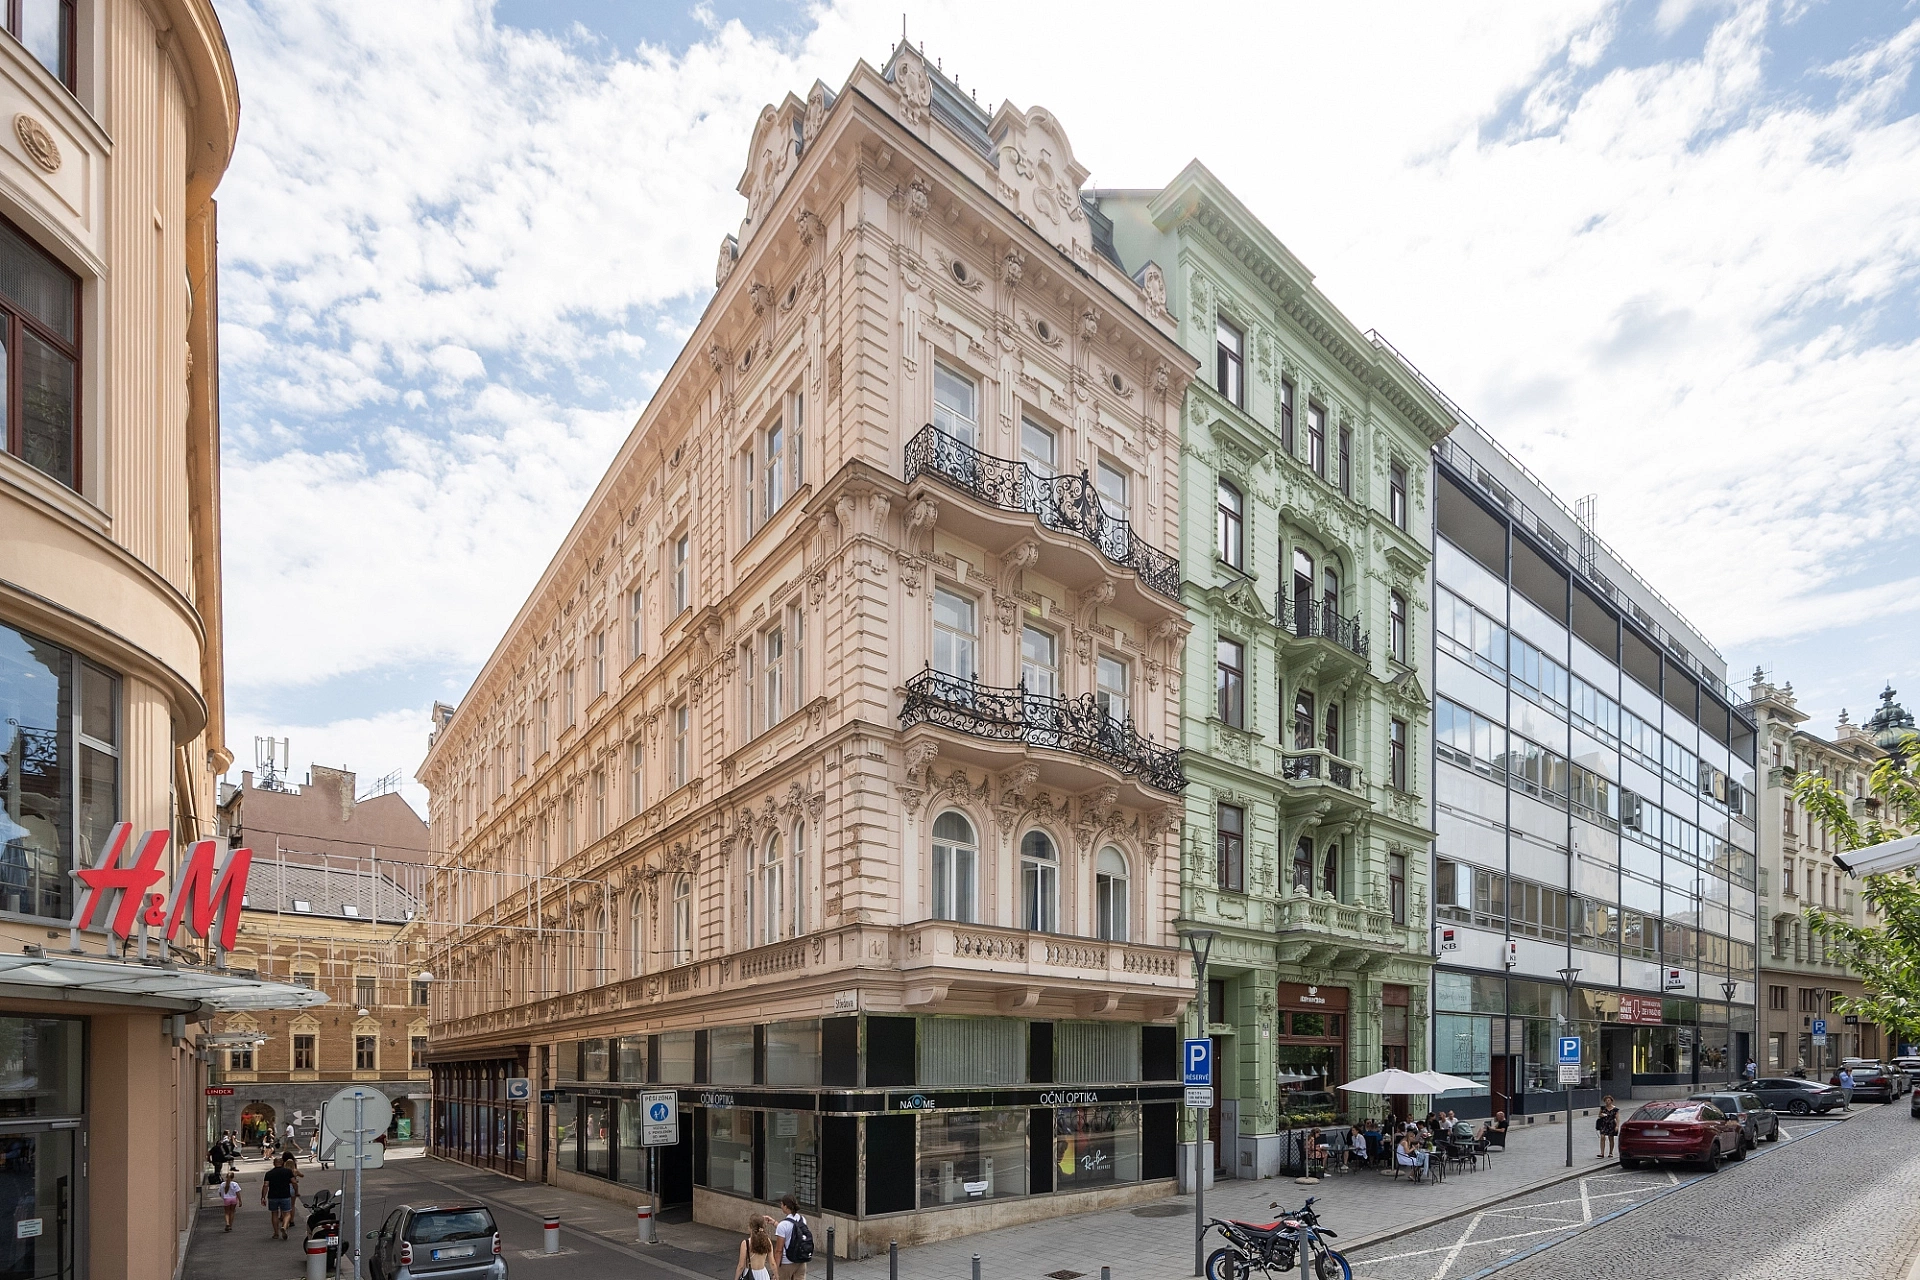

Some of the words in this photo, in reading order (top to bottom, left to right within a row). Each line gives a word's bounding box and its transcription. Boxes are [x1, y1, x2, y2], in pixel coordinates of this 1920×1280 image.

[70, 821, 252, 951] H&M
[1815, 1021, 1824, 1031] P
[1564, 1040, 1577, 1056] P
[1190, 1044, 1207, 1072] P
[714, 1094, 735, 1105] OPTIKA
[1040, 1090, 1065, 1104] OČNÍ
[1066, 1092, 1098, 1103] OPTIKA
[1081, 1149, 1107, 1171] Ray-Ban
